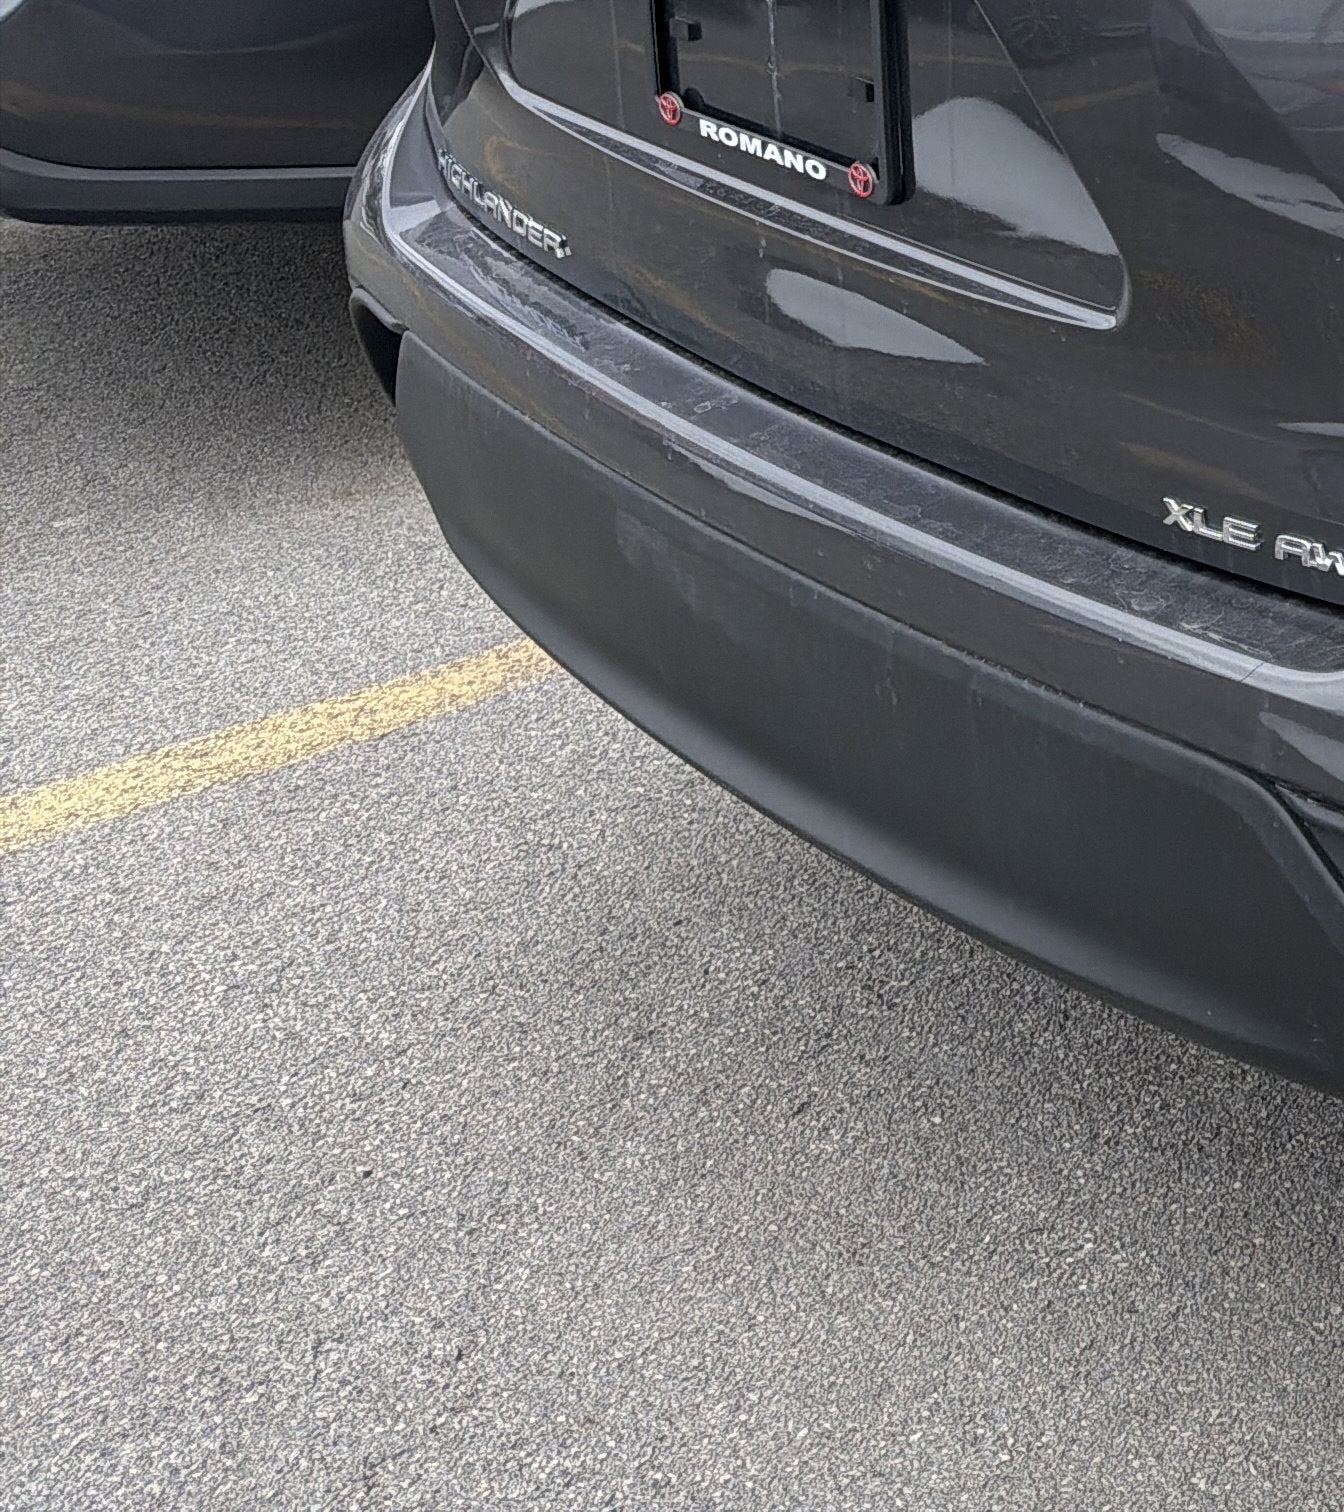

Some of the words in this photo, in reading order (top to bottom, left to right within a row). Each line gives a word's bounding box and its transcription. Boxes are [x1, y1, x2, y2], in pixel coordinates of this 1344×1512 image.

[699, 118, 827, 180] ROMANO
[438, 148, 571, 259] HIGHLANDER
[1162, 496, 1262, 551] XLE
